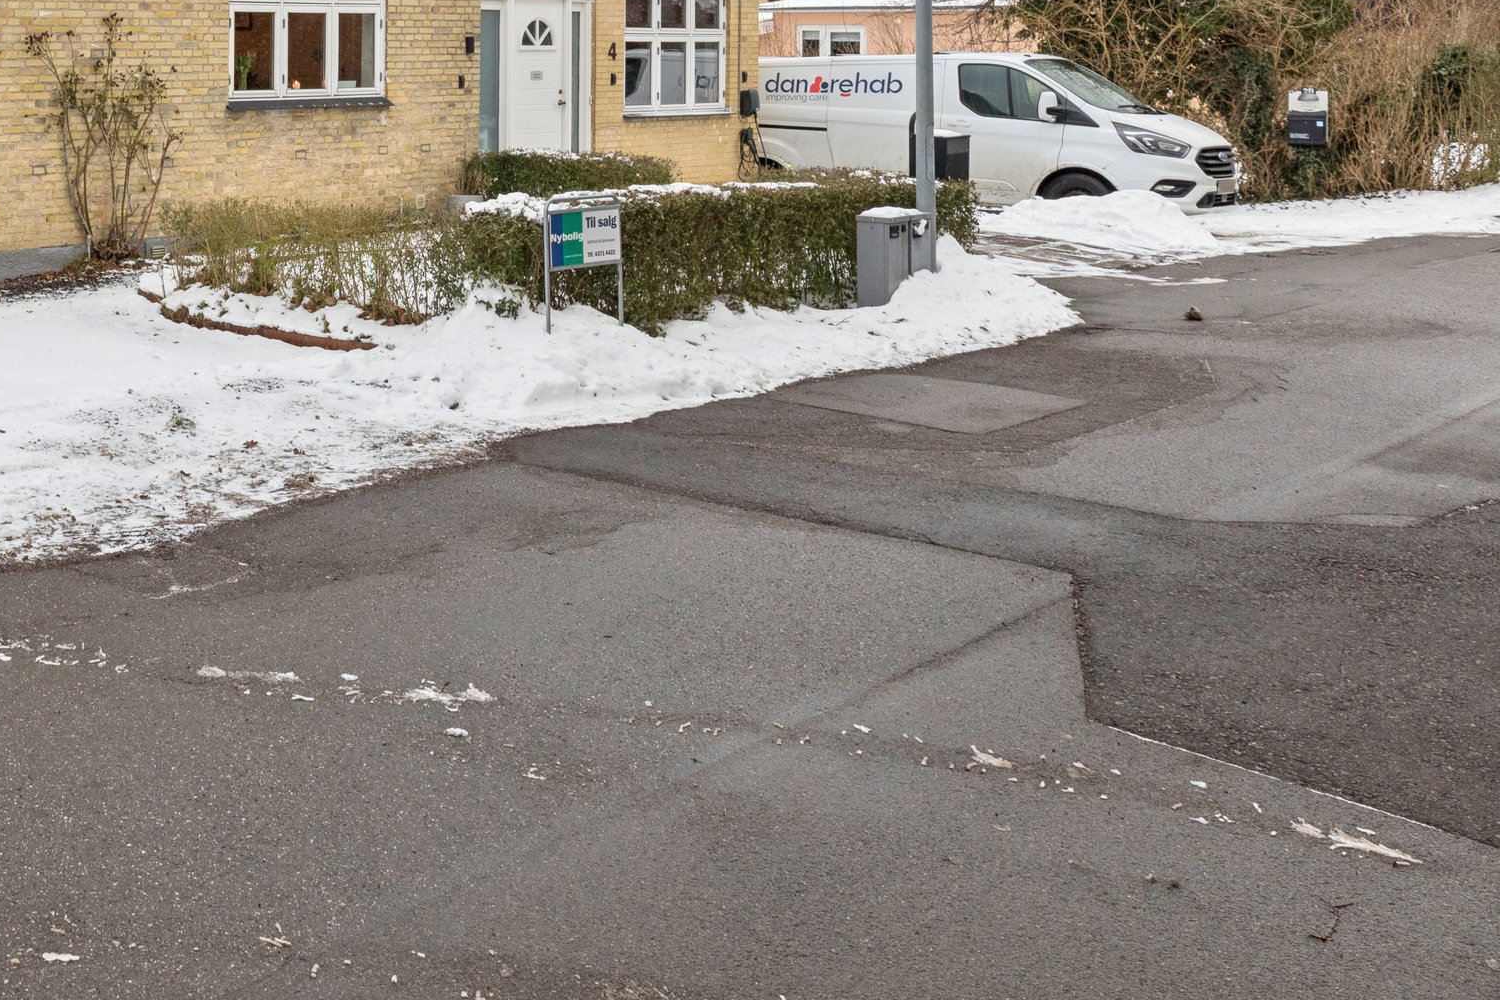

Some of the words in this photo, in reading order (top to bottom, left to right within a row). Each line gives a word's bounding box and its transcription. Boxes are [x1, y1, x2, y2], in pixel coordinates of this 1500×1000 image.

[608, 42, 617, 61] 4
[765, 94, 808, 103] improving
[586, 216, 596, 229] Til
[598, 214, 617, 229] salg
[550, 231, 583, 245] Nybolig
